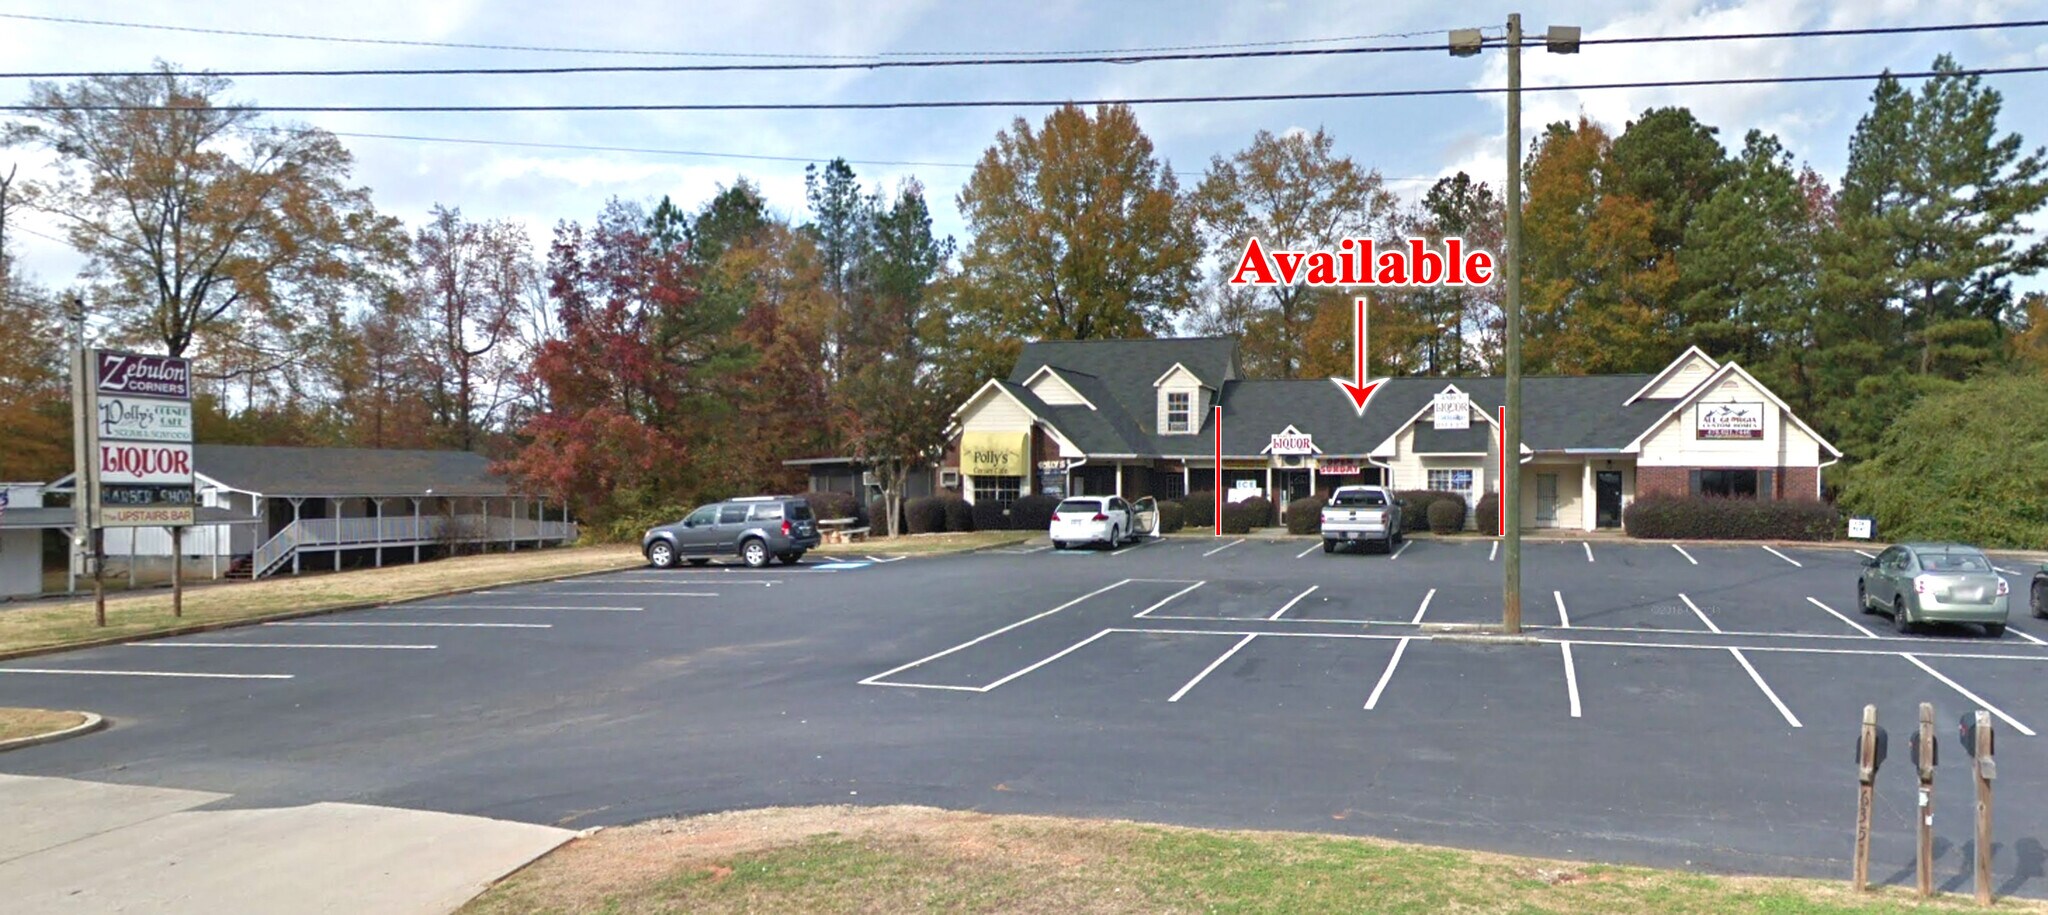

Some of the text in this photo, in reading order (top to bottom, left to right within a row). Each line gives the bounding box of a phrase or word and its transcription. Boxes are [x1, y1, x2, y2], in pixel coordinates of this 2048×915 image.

[100, 355, 185, 390] Zebulon
[128, 381, 185, 393] CORNERS
[99, 400, 153, 434] Polly's
[1273, 438, 1310, 449] LIQUOR
[101, 447, 189, 478] LIQUOR
[974, 450, 1009, 467] Polly's
[118, 510, 169, 521] UPSTAIRS
[171, 510, 191, 521] BAR
